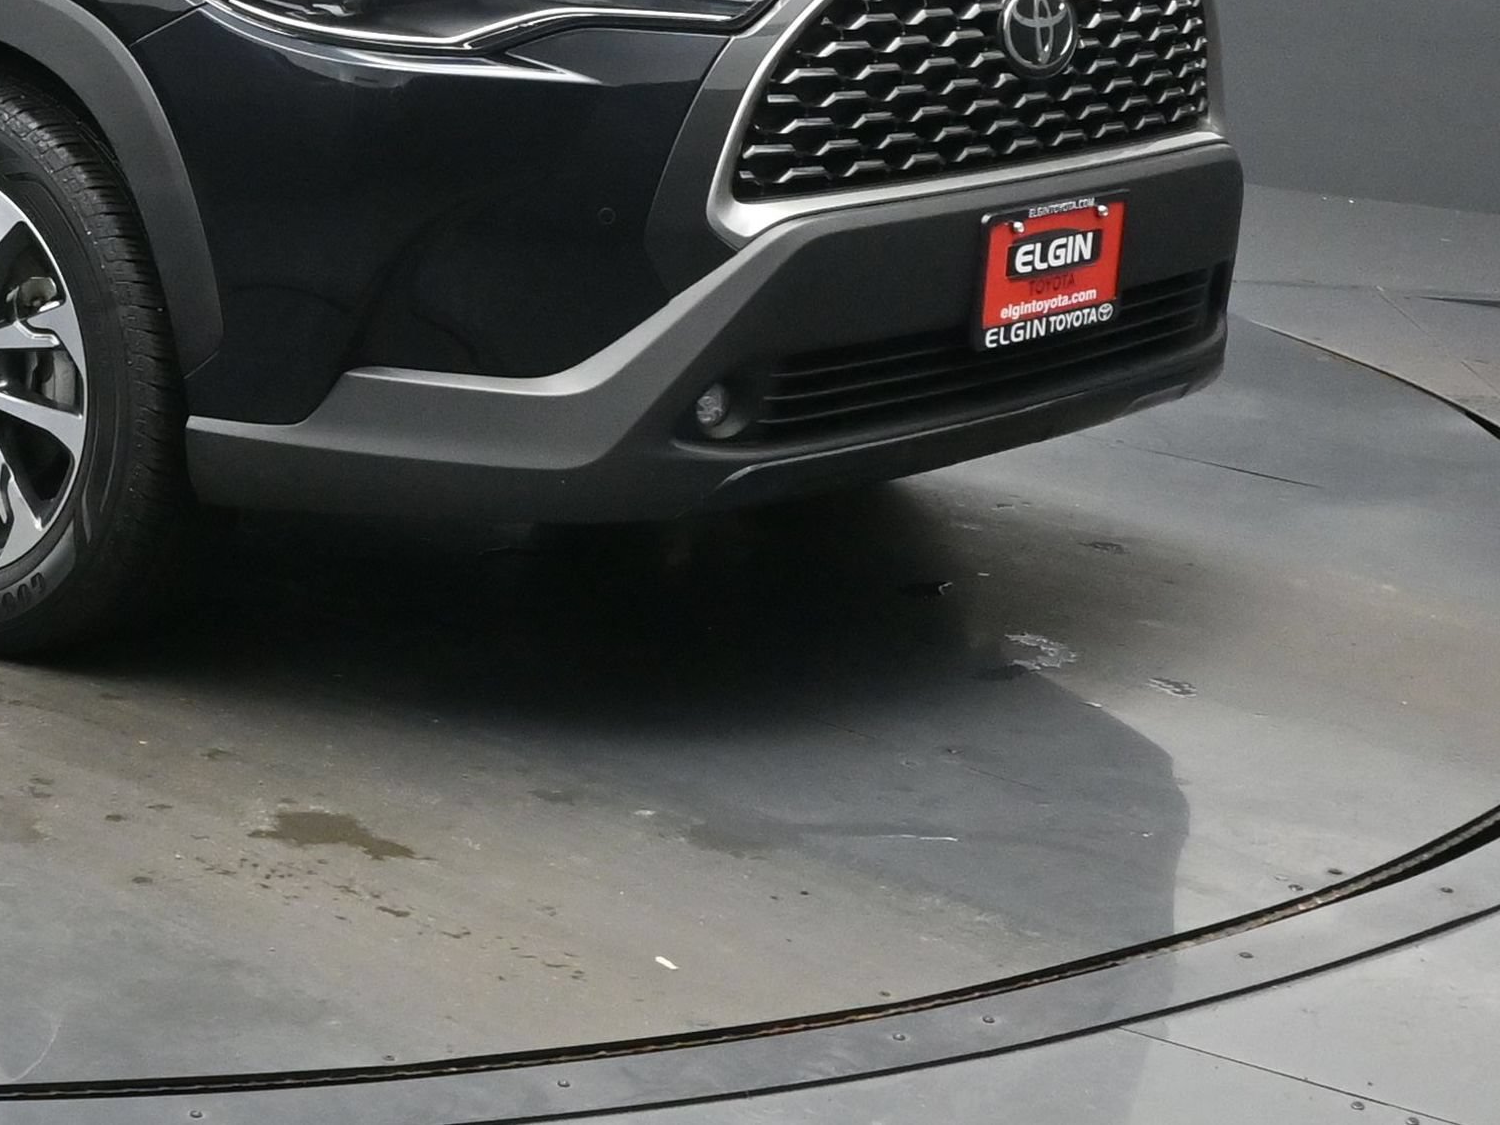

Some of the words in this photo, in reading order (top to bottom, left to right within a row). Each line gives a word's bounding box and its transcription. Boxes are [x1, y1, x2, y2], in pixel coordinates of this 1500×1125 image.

[1028, 197, 1095, 218] ELGINTOYOTA.COM
[1015, 232, 1093, 273] ELGIN
[1029, 274, 1075, 295] TOYOTA
[1000, 289, 1097, 320] elgintoyota.com
[985, 317, 1046, 348] ELGIN
[1049, 307, 1097, 333] TOYOTA
